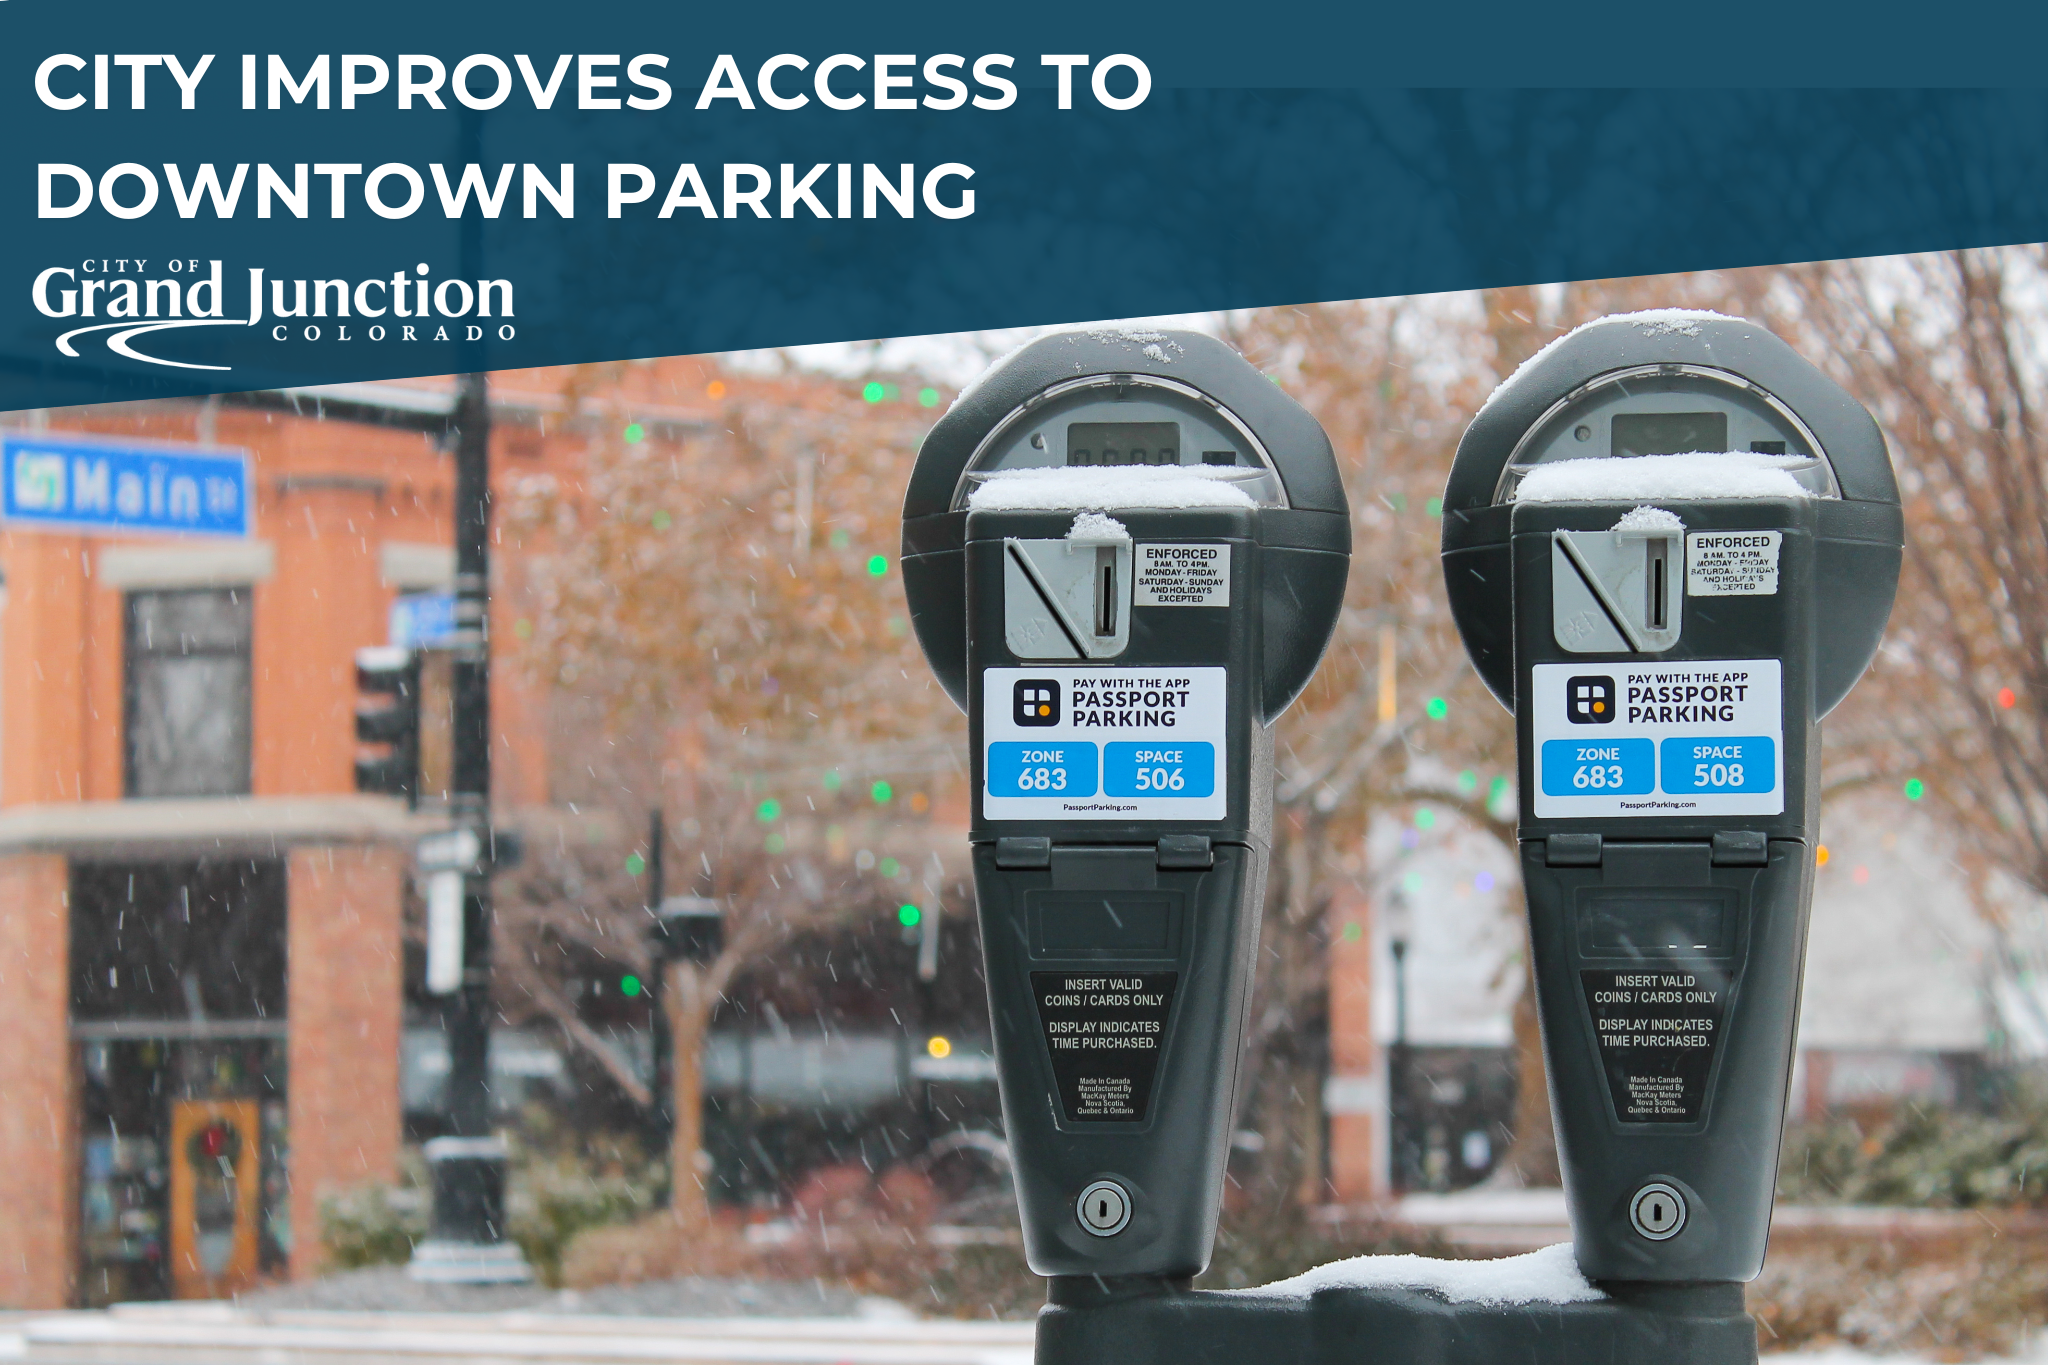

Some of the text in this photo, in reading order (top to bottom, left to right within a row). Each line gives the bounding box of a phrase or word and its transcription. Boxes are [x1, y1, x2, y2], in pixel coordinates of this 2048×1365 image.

[73, 456, 199, 521] Main
[1697, 537, 1770, 548] ENFORCED
[1147, 549, 1217, 559] ENFORCED
[1074, 679, 1190, 687] PAY WITH THE APP
[1628, 673, 1748, 683] PAY WITH THE APP
[1073, 691, 1189, 707] PASSPORT
[1629, 685, 1748, 703] PASSPORT
[1074, 711, 1175, 726] PARKING
[1629, 706, 1733, 723] PARKING
[1022, 751, 1063, 762] ZONE
[1136, 751, 1182, 762] SPACE
[1577, 748, 1619, 760] ZONE
[1693, 746, 1742, 758] SPACE
[1018, 768, 1066, 790] 683
[1136, 768, 1184, 790] 506
[1573, 766, 1623, 788] 683
[1694, 764, 1744, 786] 508
[1620, 801, 1696, 809] PassportParking.com
[1066, 979, 1142, 990] INSERT VALID
[1616, 976, 1695, 986] INSERT VALID
[1046, 995, 1163, 1006] COINS / CARDS ONLY
[1595, 992, 1717, 1003] COINS / CARDS ONLY
[1050, 1022, 1159, 1032] DISPLAY INDICATES
[1600, 1019, 1713, 1030] DISPLAY INDICATES
[1053, 1038, 1156, 1048] TIME PURCHASED.
[1602, 1035, 1709, 1046] TIME PURCHASED.
[1123, 1085, 1132, 1093] By
[1676, 1084, 1684, 1092] By
